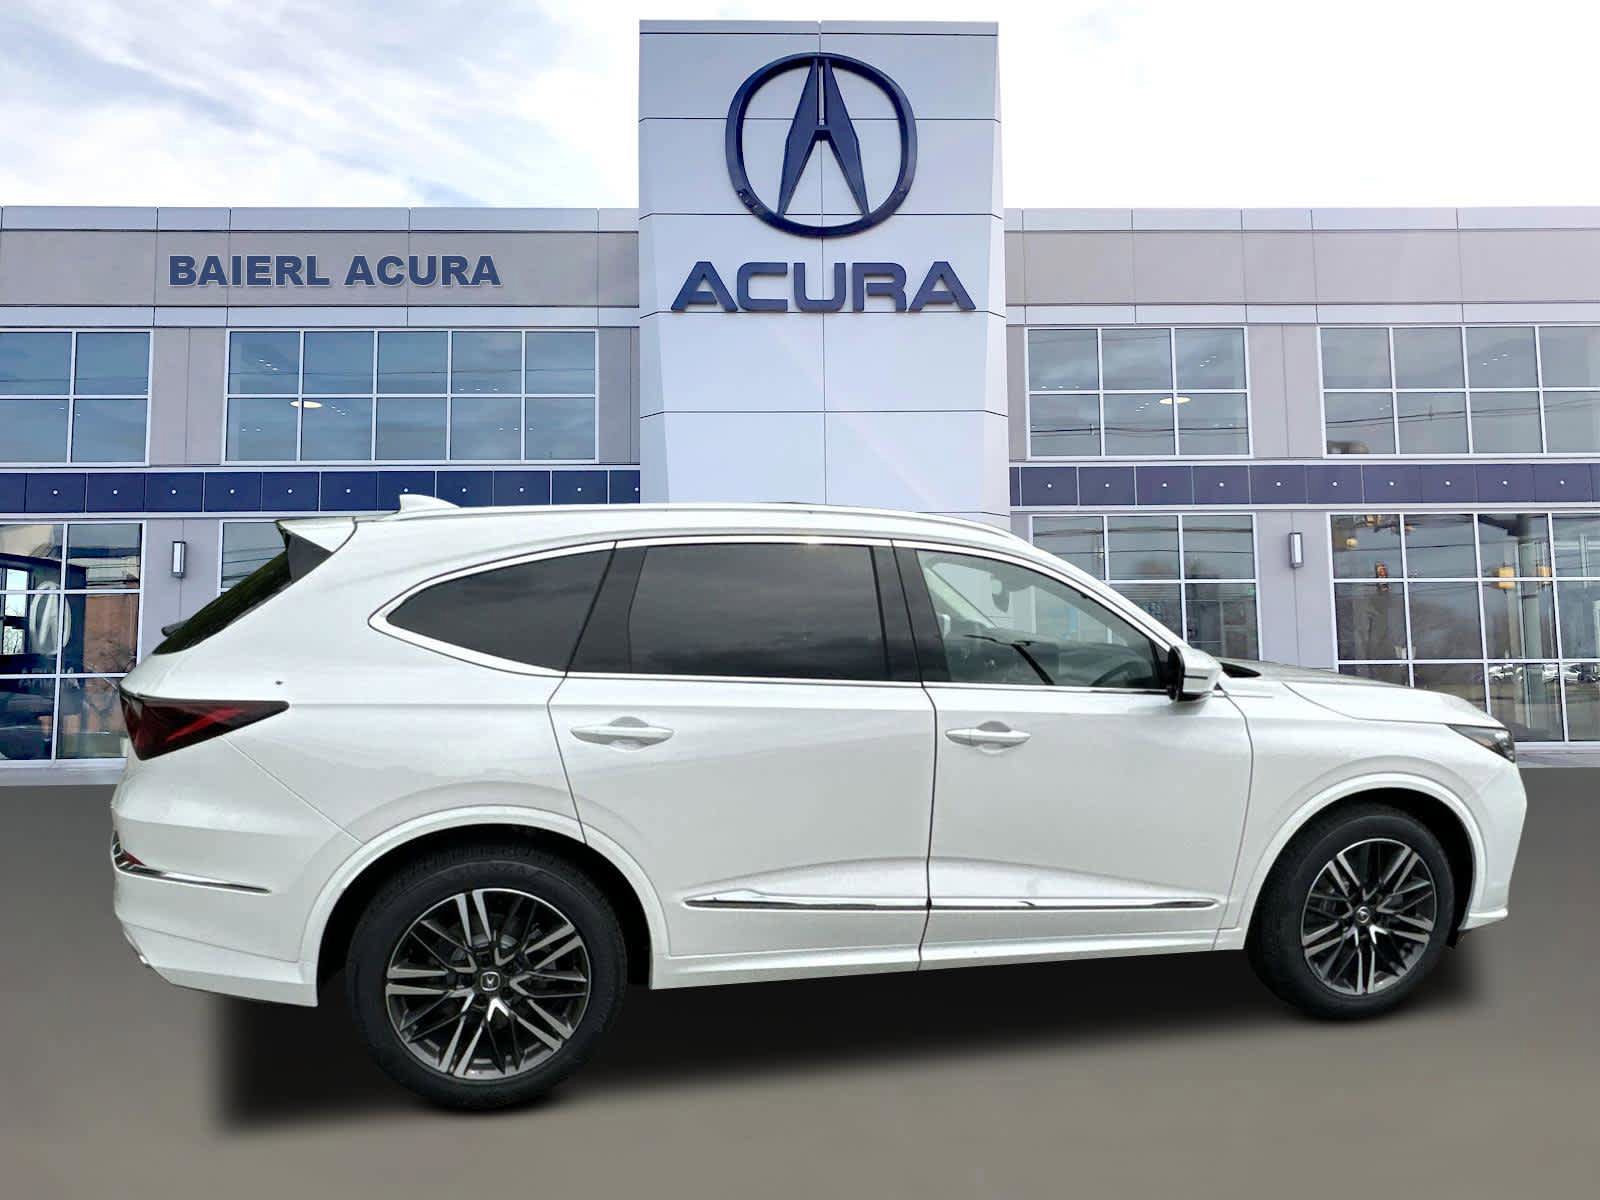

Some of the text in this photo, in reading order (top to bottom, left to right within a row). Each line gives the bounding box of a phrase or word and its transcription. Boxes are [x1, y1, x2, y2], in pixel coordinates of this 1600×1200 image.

[169, 255, 502, 286] BAIERL ACURA
[671, 261, 976, 312] ACURA
